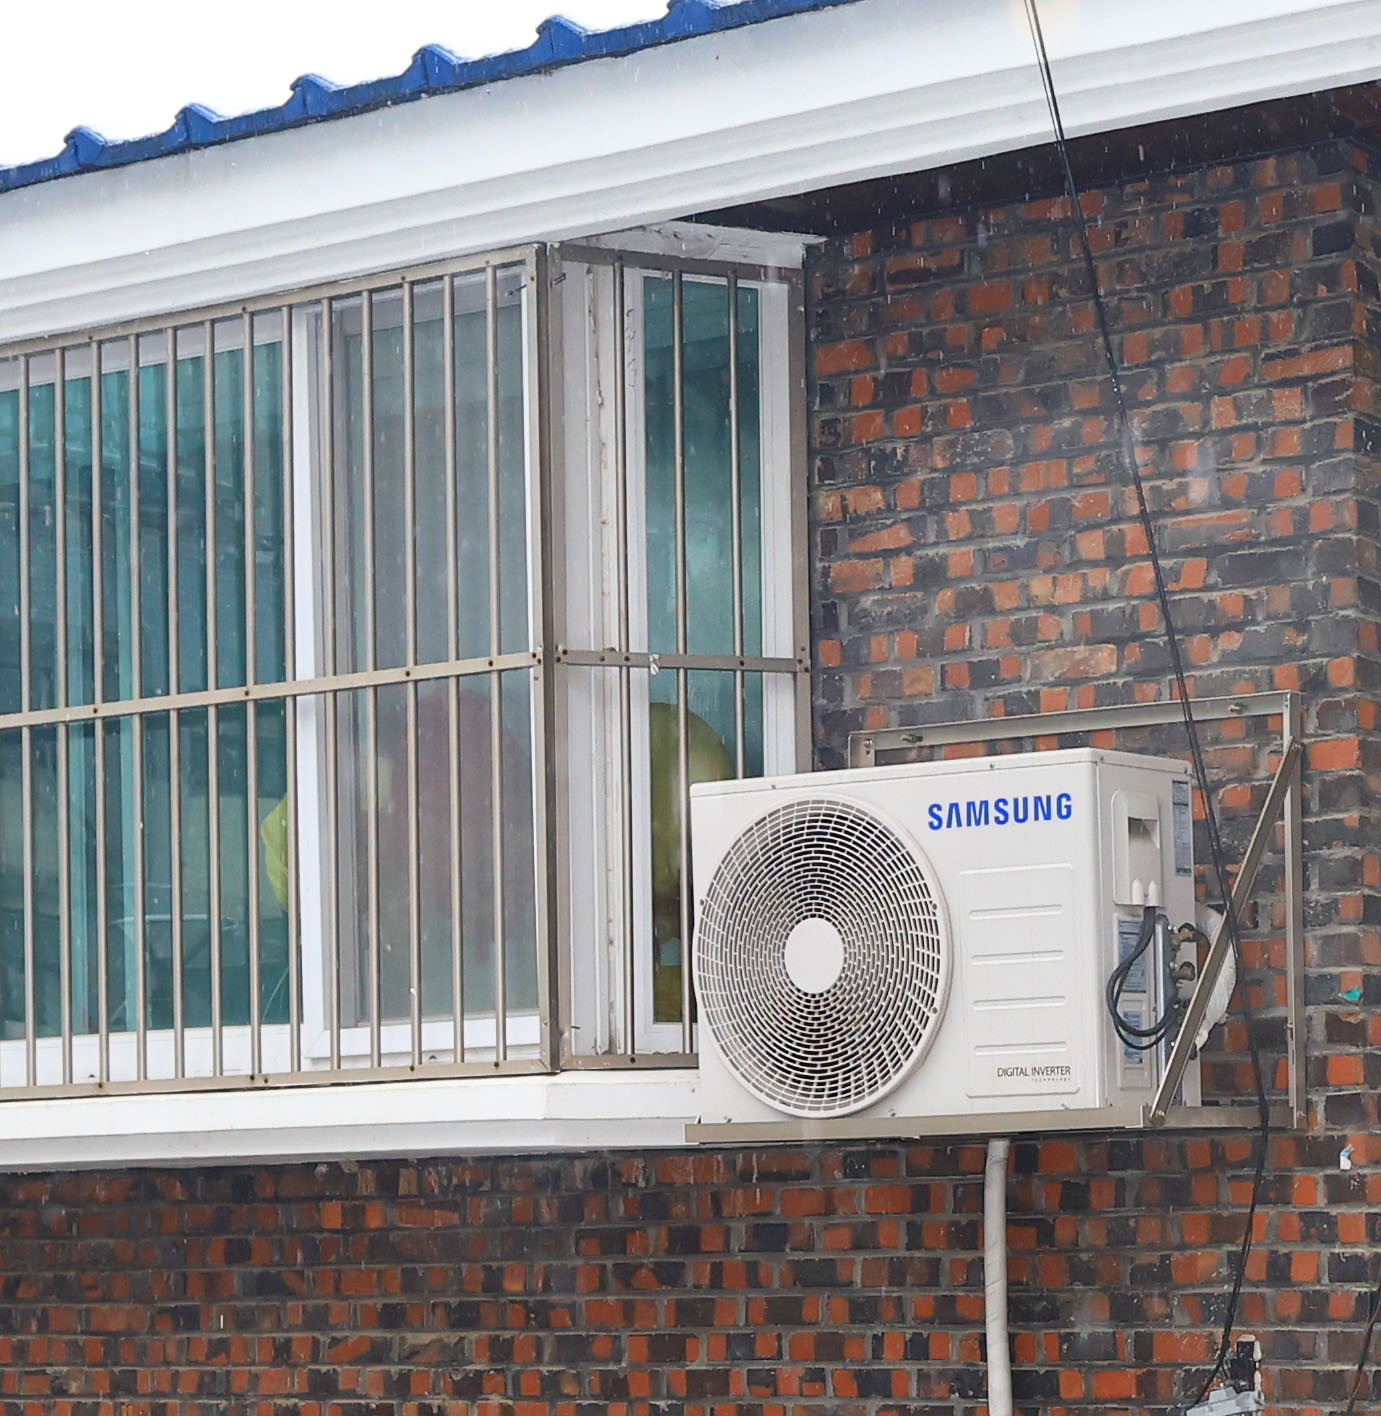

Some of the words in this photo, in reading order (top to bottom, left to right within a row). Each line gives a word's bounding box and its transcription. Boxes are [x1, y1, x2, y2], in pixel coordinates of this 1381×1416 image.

[928, 793, 1072, 830] SAMSUNG
[997, 1067, 1030, 1077] DIGITAL
[1031, 1066, 1071, 1076] INVERTER
